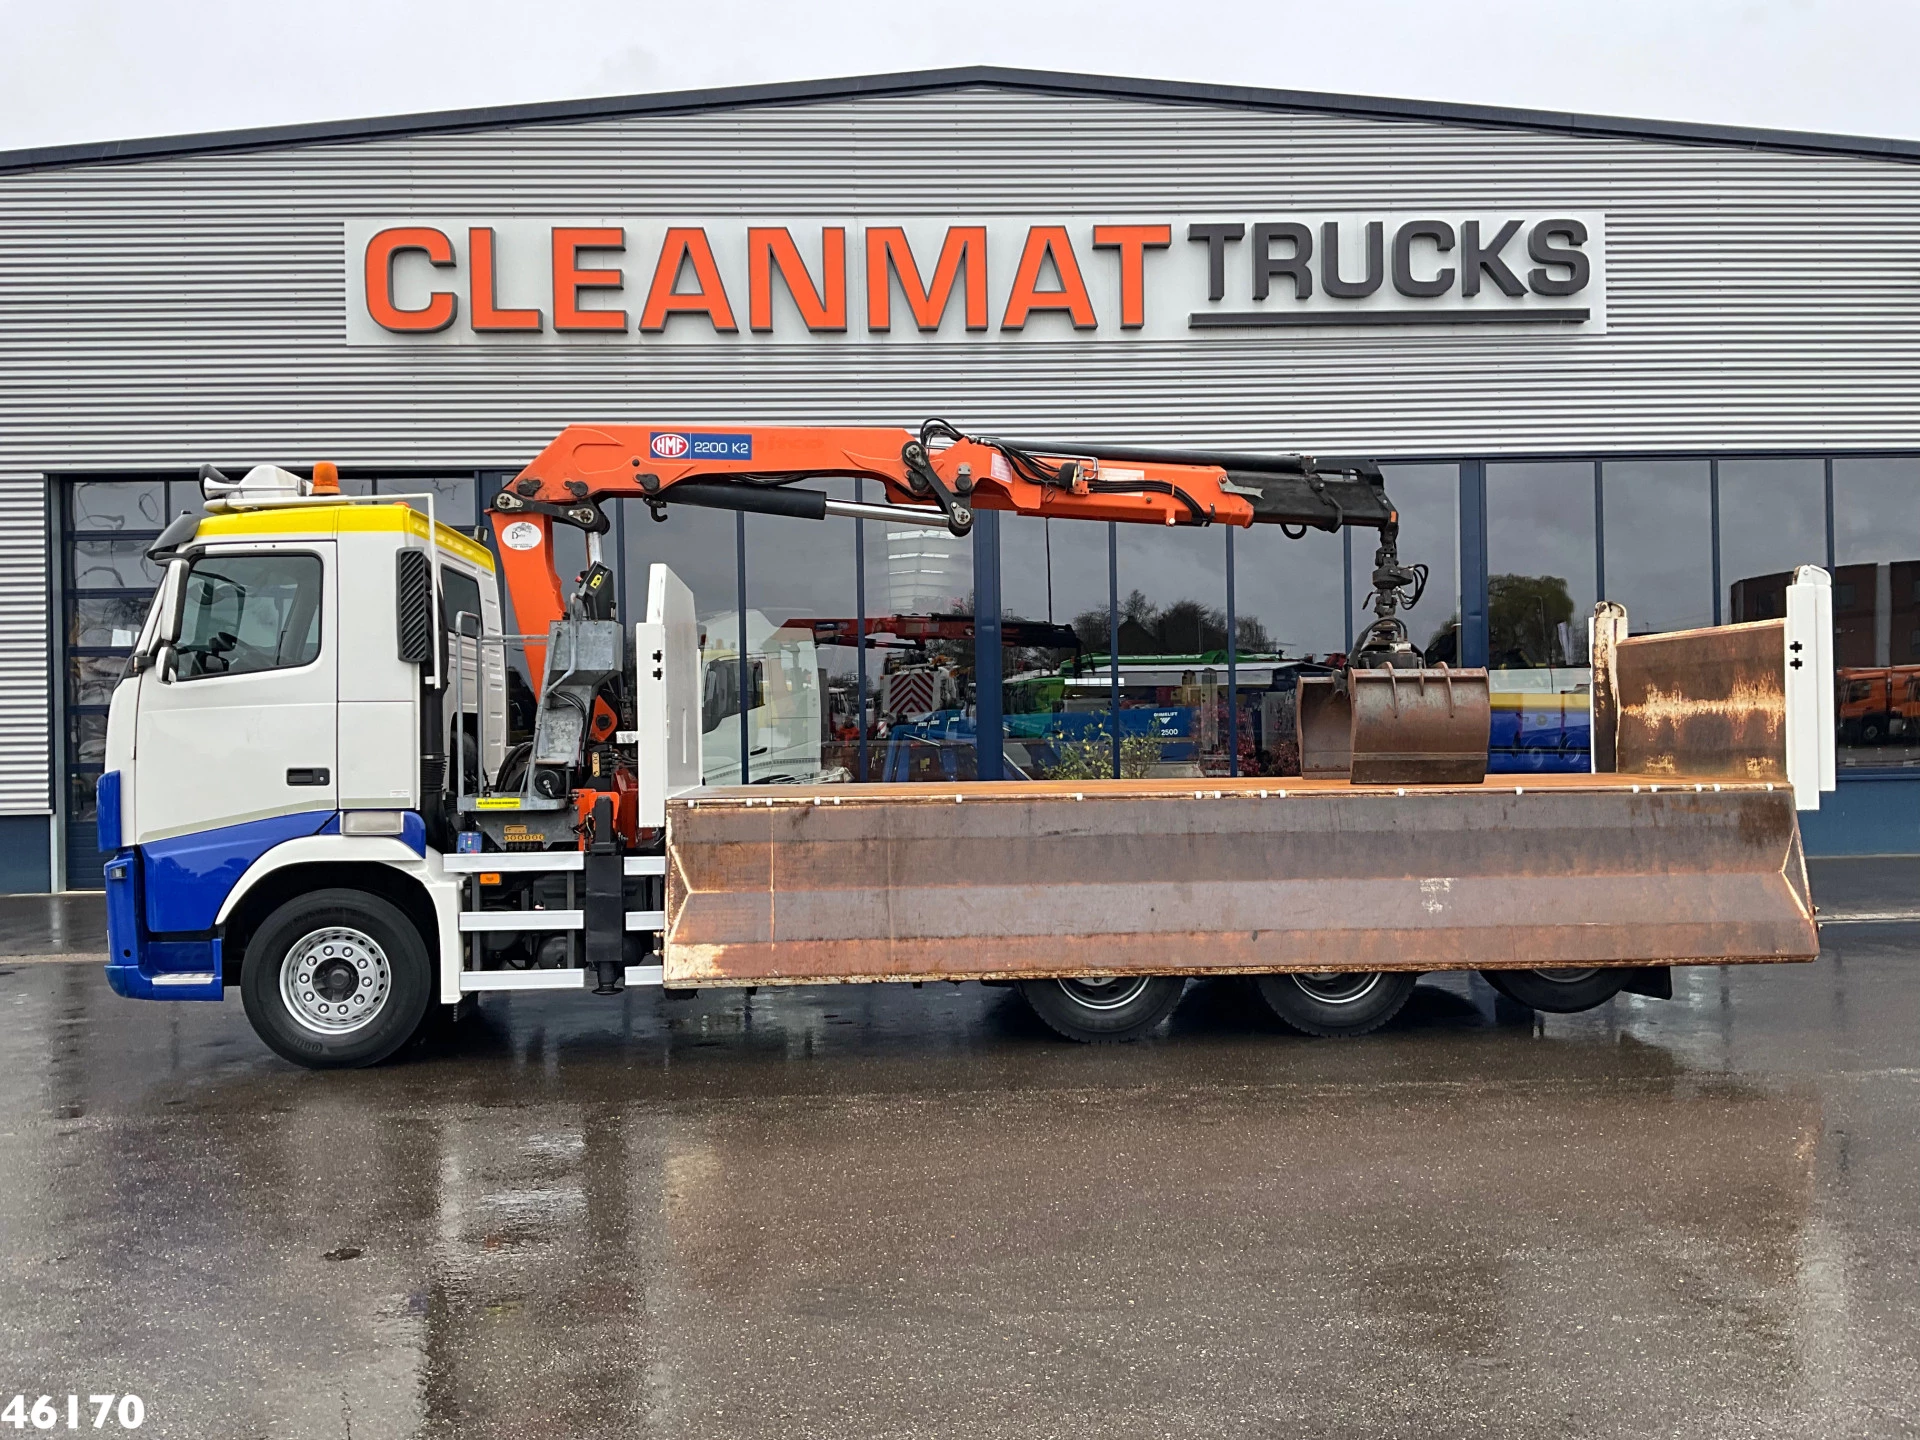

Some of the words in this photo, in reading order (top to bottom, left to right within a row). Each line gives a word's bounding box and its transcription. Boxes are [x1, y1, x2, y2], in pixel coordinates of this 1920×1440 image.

[364, 225, 1172, 334] CLEANMAT
[1187, 218, 1590, 301] TRUCKS
[656, 435, 685, 455] HMF
[694, 441, 728, 453] 2200
[732, 442, 749, 454] K2
[1161, 728, 1178, 736] 2500
